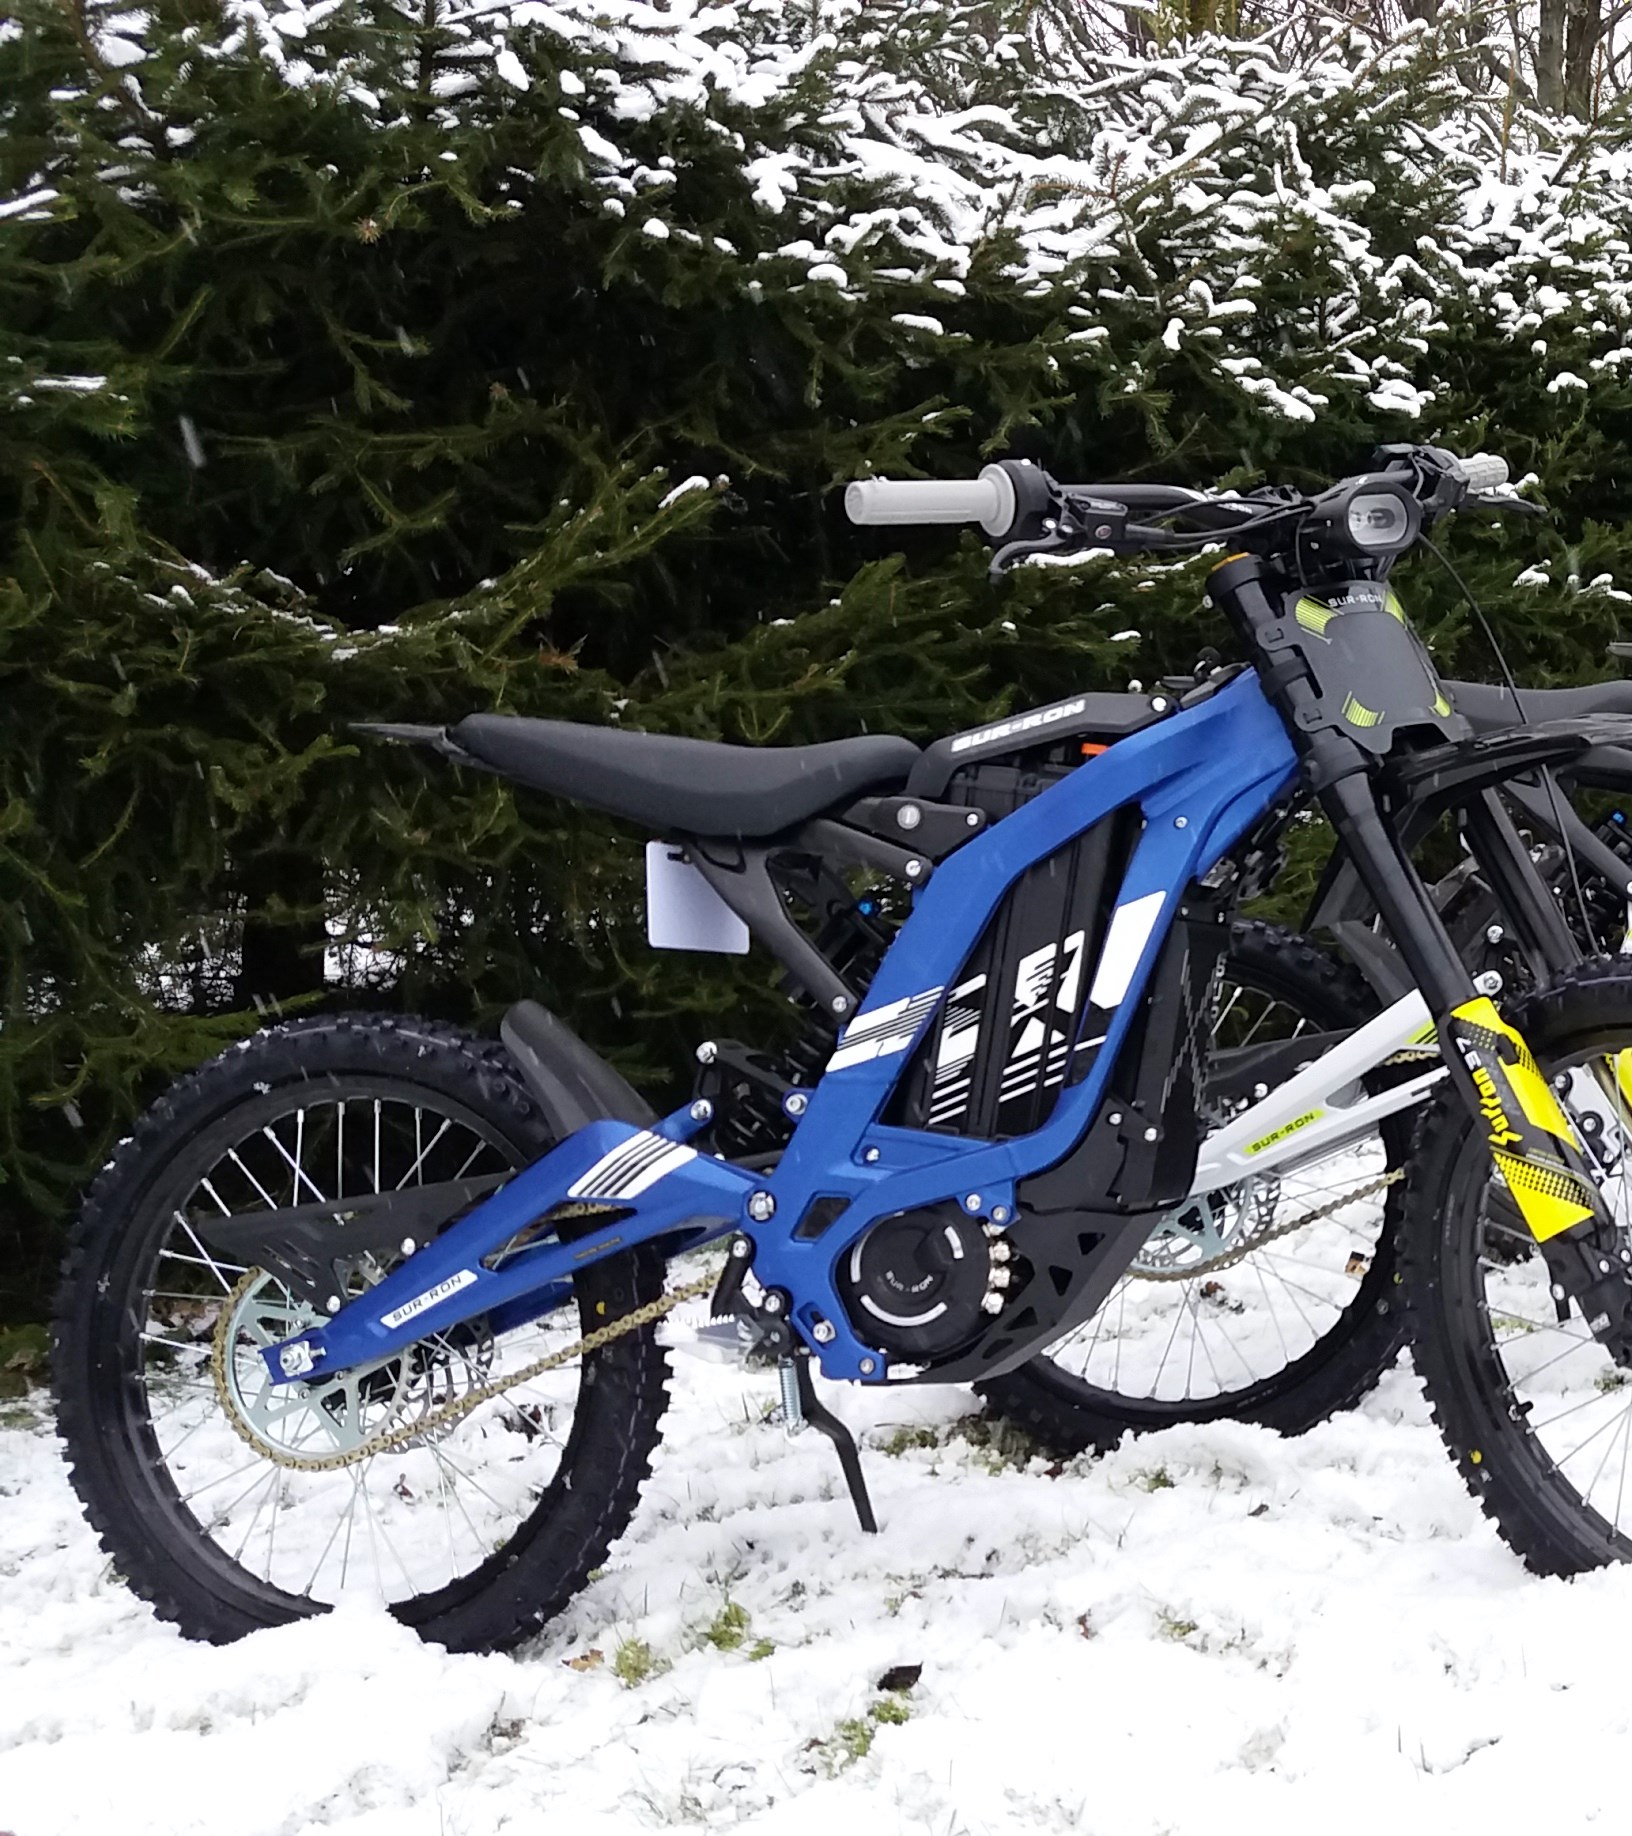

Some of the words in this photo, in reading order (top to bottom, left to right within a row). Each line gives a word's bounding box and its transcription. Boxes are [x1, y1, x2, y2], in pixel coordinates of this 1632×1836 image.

[951, 699, 1086, 752] SUR-RON
[1252, 1112, 1314, 1152] SUR-RON
[392, 1274, 462, 1322] SUR-RON
